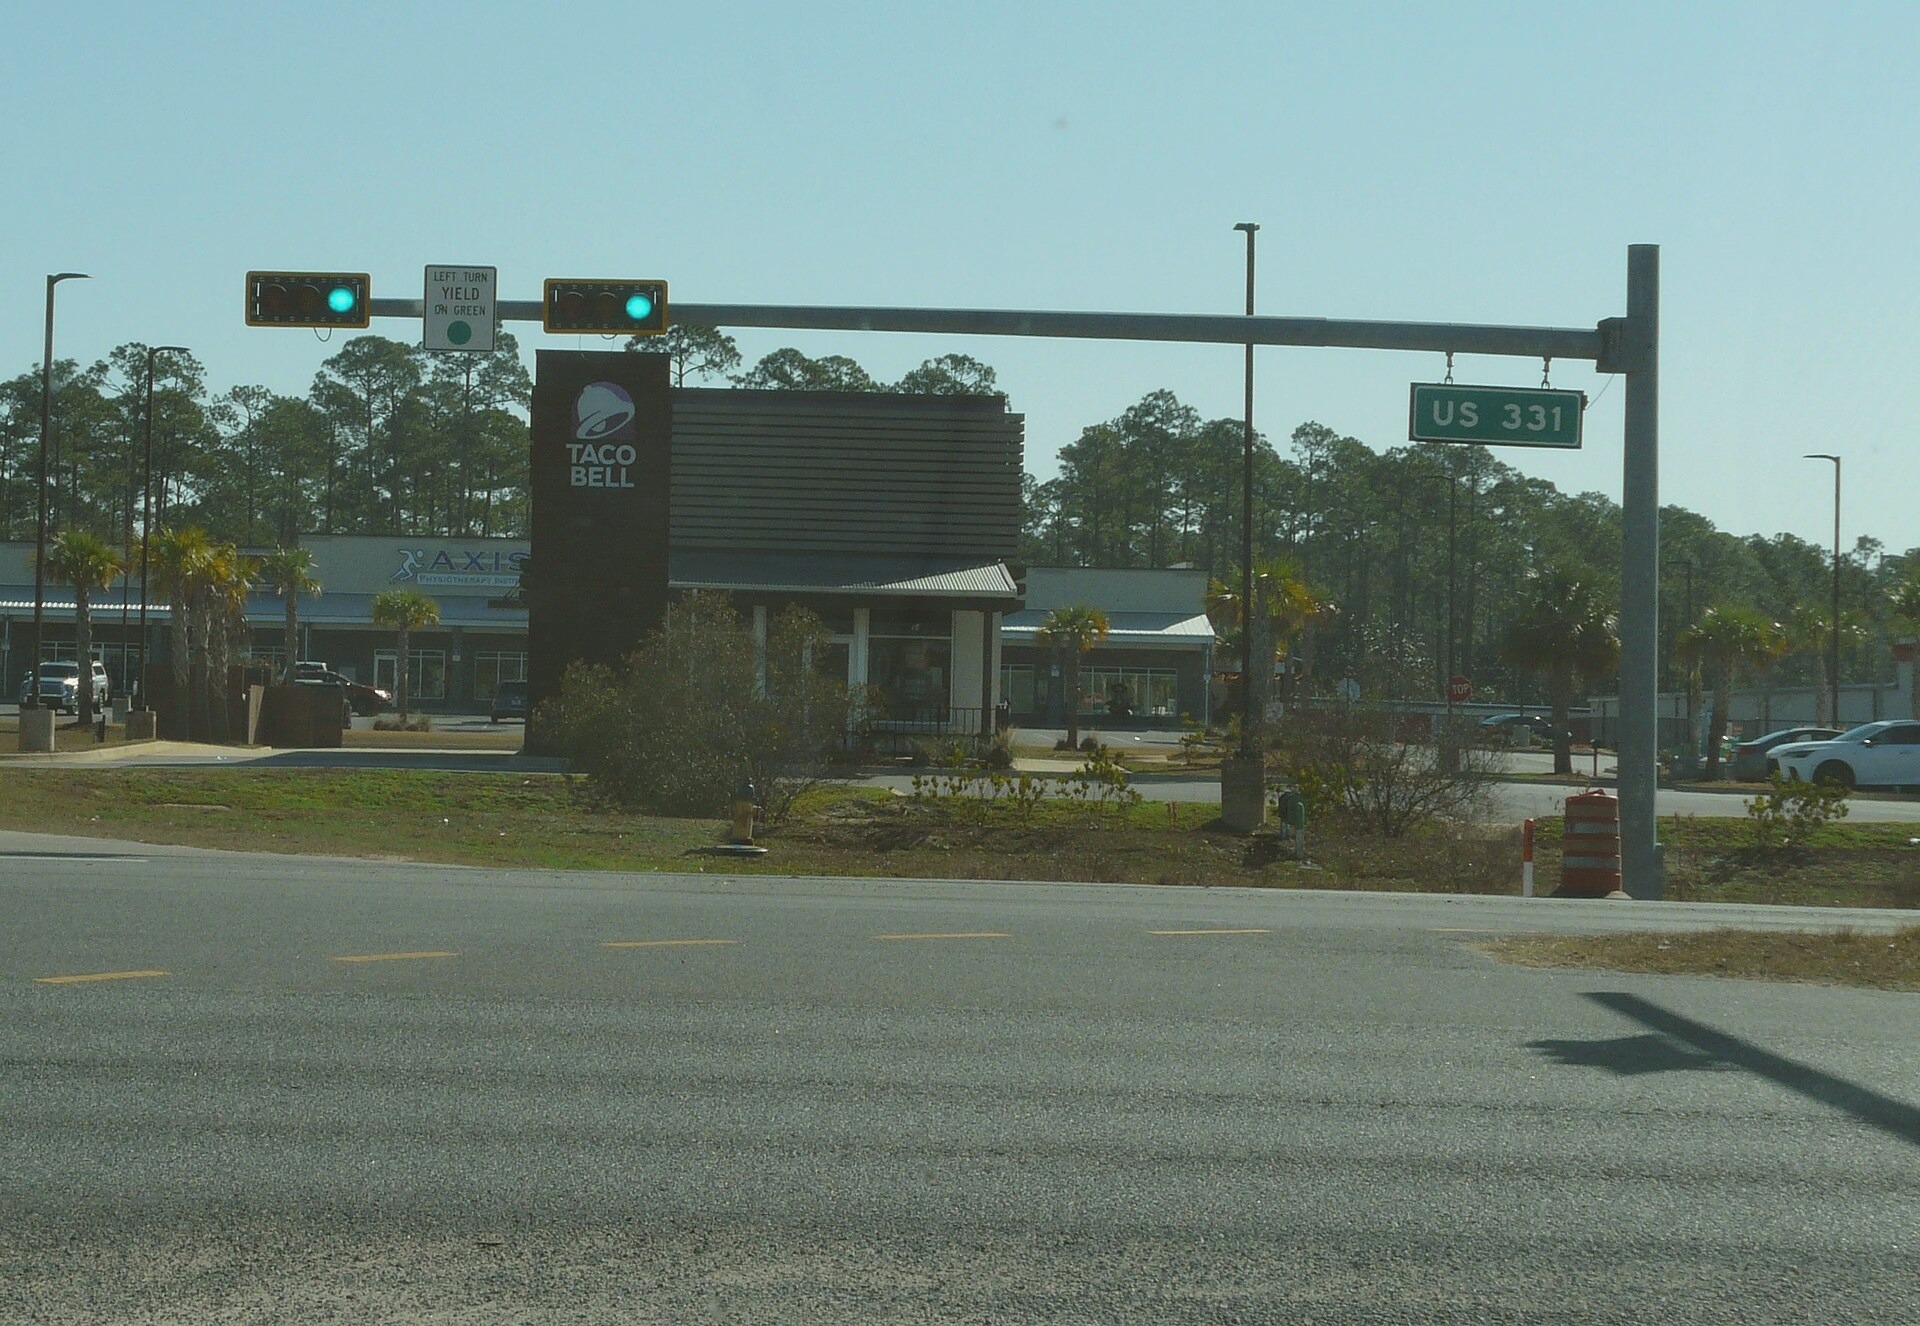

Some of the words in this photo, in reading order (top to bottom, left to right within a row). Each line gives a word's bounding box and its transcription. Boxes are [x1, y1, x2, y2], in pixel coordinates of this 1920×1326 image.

[434, 271, 456, 282] LEFT
[464, 272, 488, 283] TURN
[442, 287, 480, 300] YIELD
[434, 304, 448, 315] ON
[454, 305, 486, 316] GREEN
[1433, 400, 1479, 428] US
[1502, 403, 1562, 432] 331
[566, 443, 637, 465] TACO
[570, 466, 635, 488] BELL
[429, 550, 530, 572] AXIS
[1451, 684, 1470, 695] TOP
